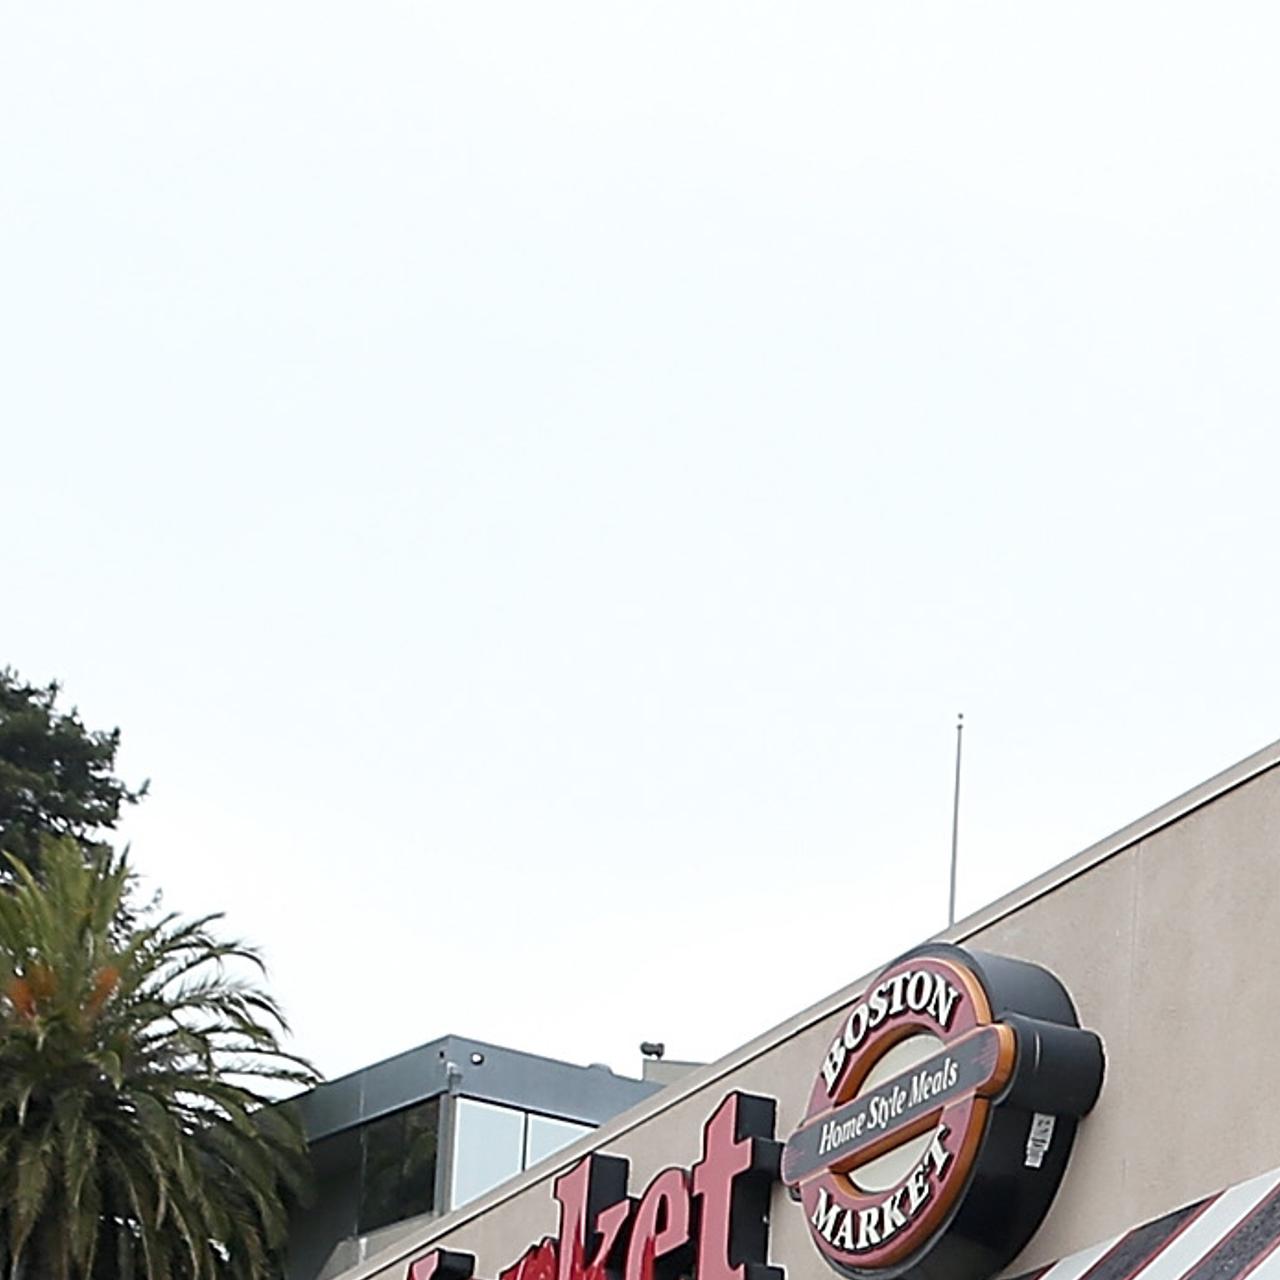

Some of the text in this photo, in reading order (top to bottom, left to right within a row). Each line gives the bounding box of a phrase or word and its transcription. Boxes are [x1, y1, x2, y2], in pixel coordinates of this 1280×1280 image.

[821, 969, 959, 1093] BOSTON
[818, 1056, 959, 1156] Home Style Meals
[810, 1124, 952, 1251] MARKET
